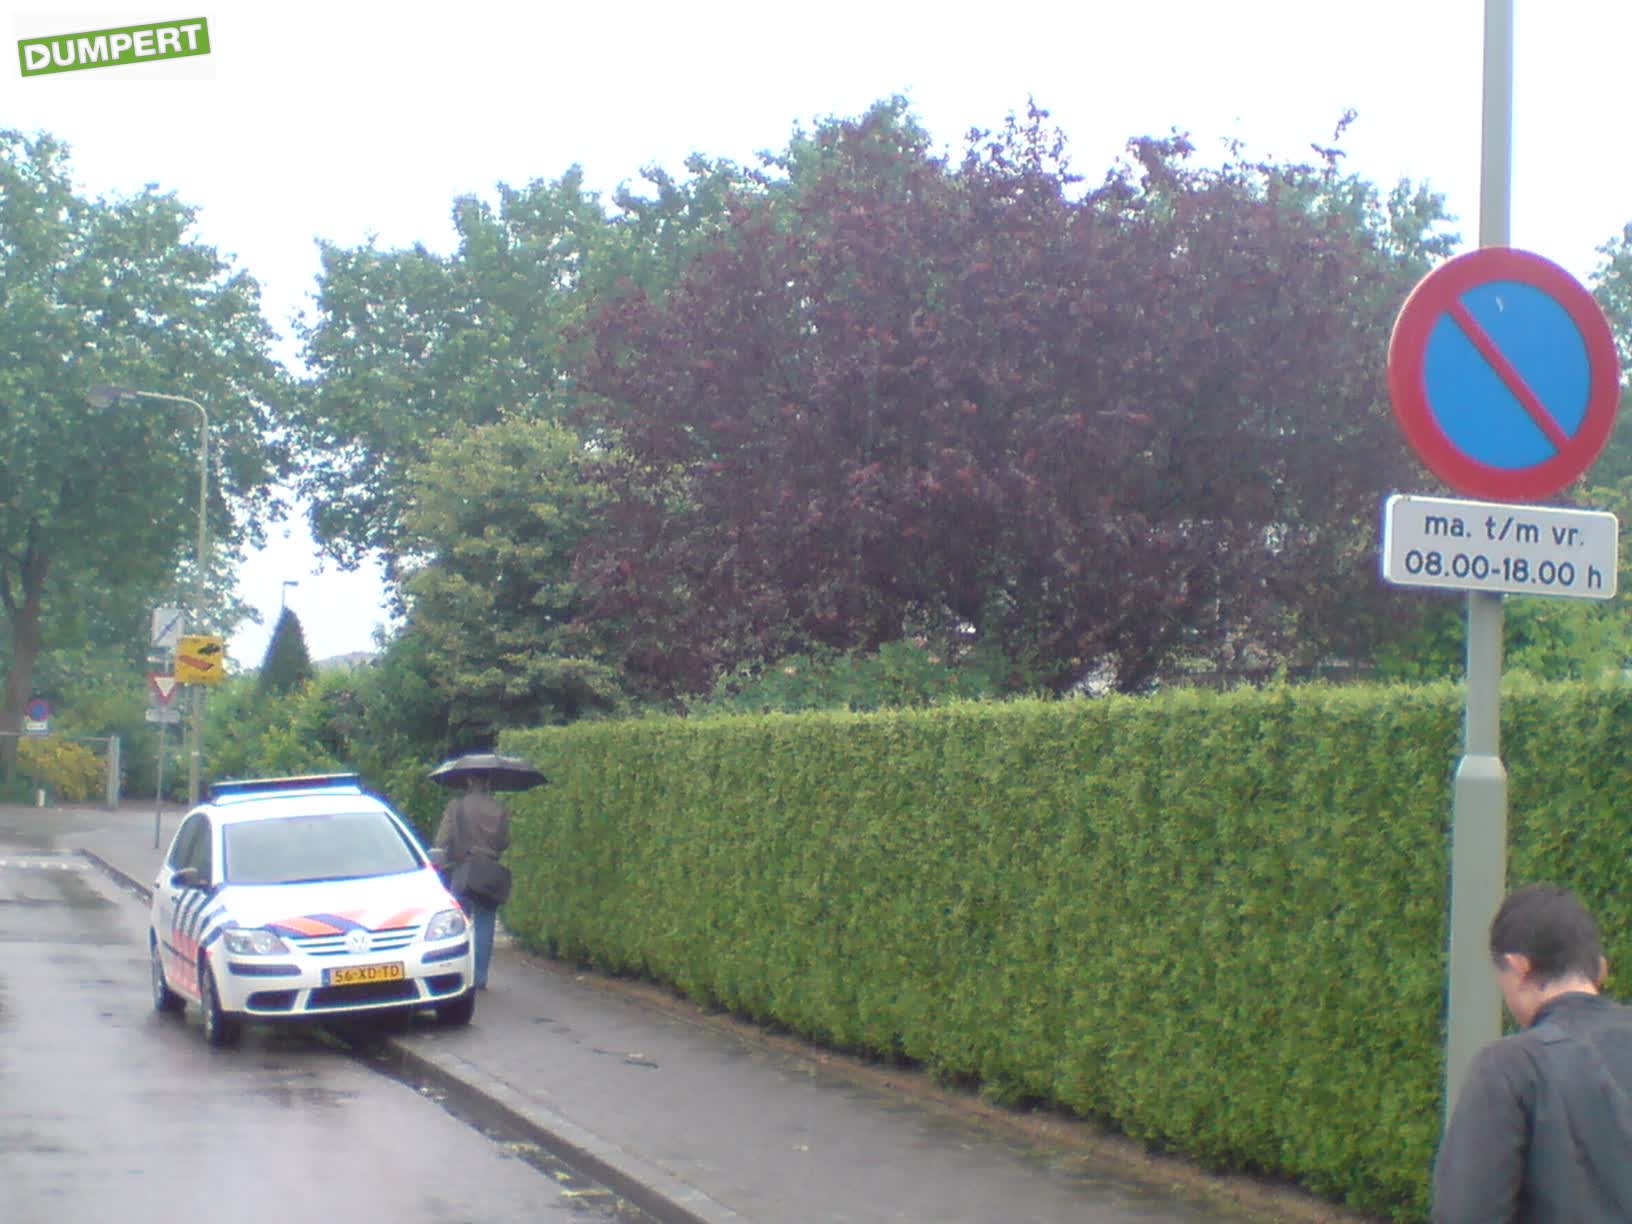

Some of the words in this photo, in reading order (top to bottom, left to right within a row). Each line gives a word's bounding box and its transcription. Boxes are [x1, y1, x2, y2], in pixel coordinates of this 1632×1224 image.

[1424, 515, 1472, 538] ma.
[1485, 515, 1539, 543] t/m
[1552, 525, 1584, 546] vr.
[1405, 549, 1575, 586] 08.00-18.00
[1587, 564, 1602, 589] h
